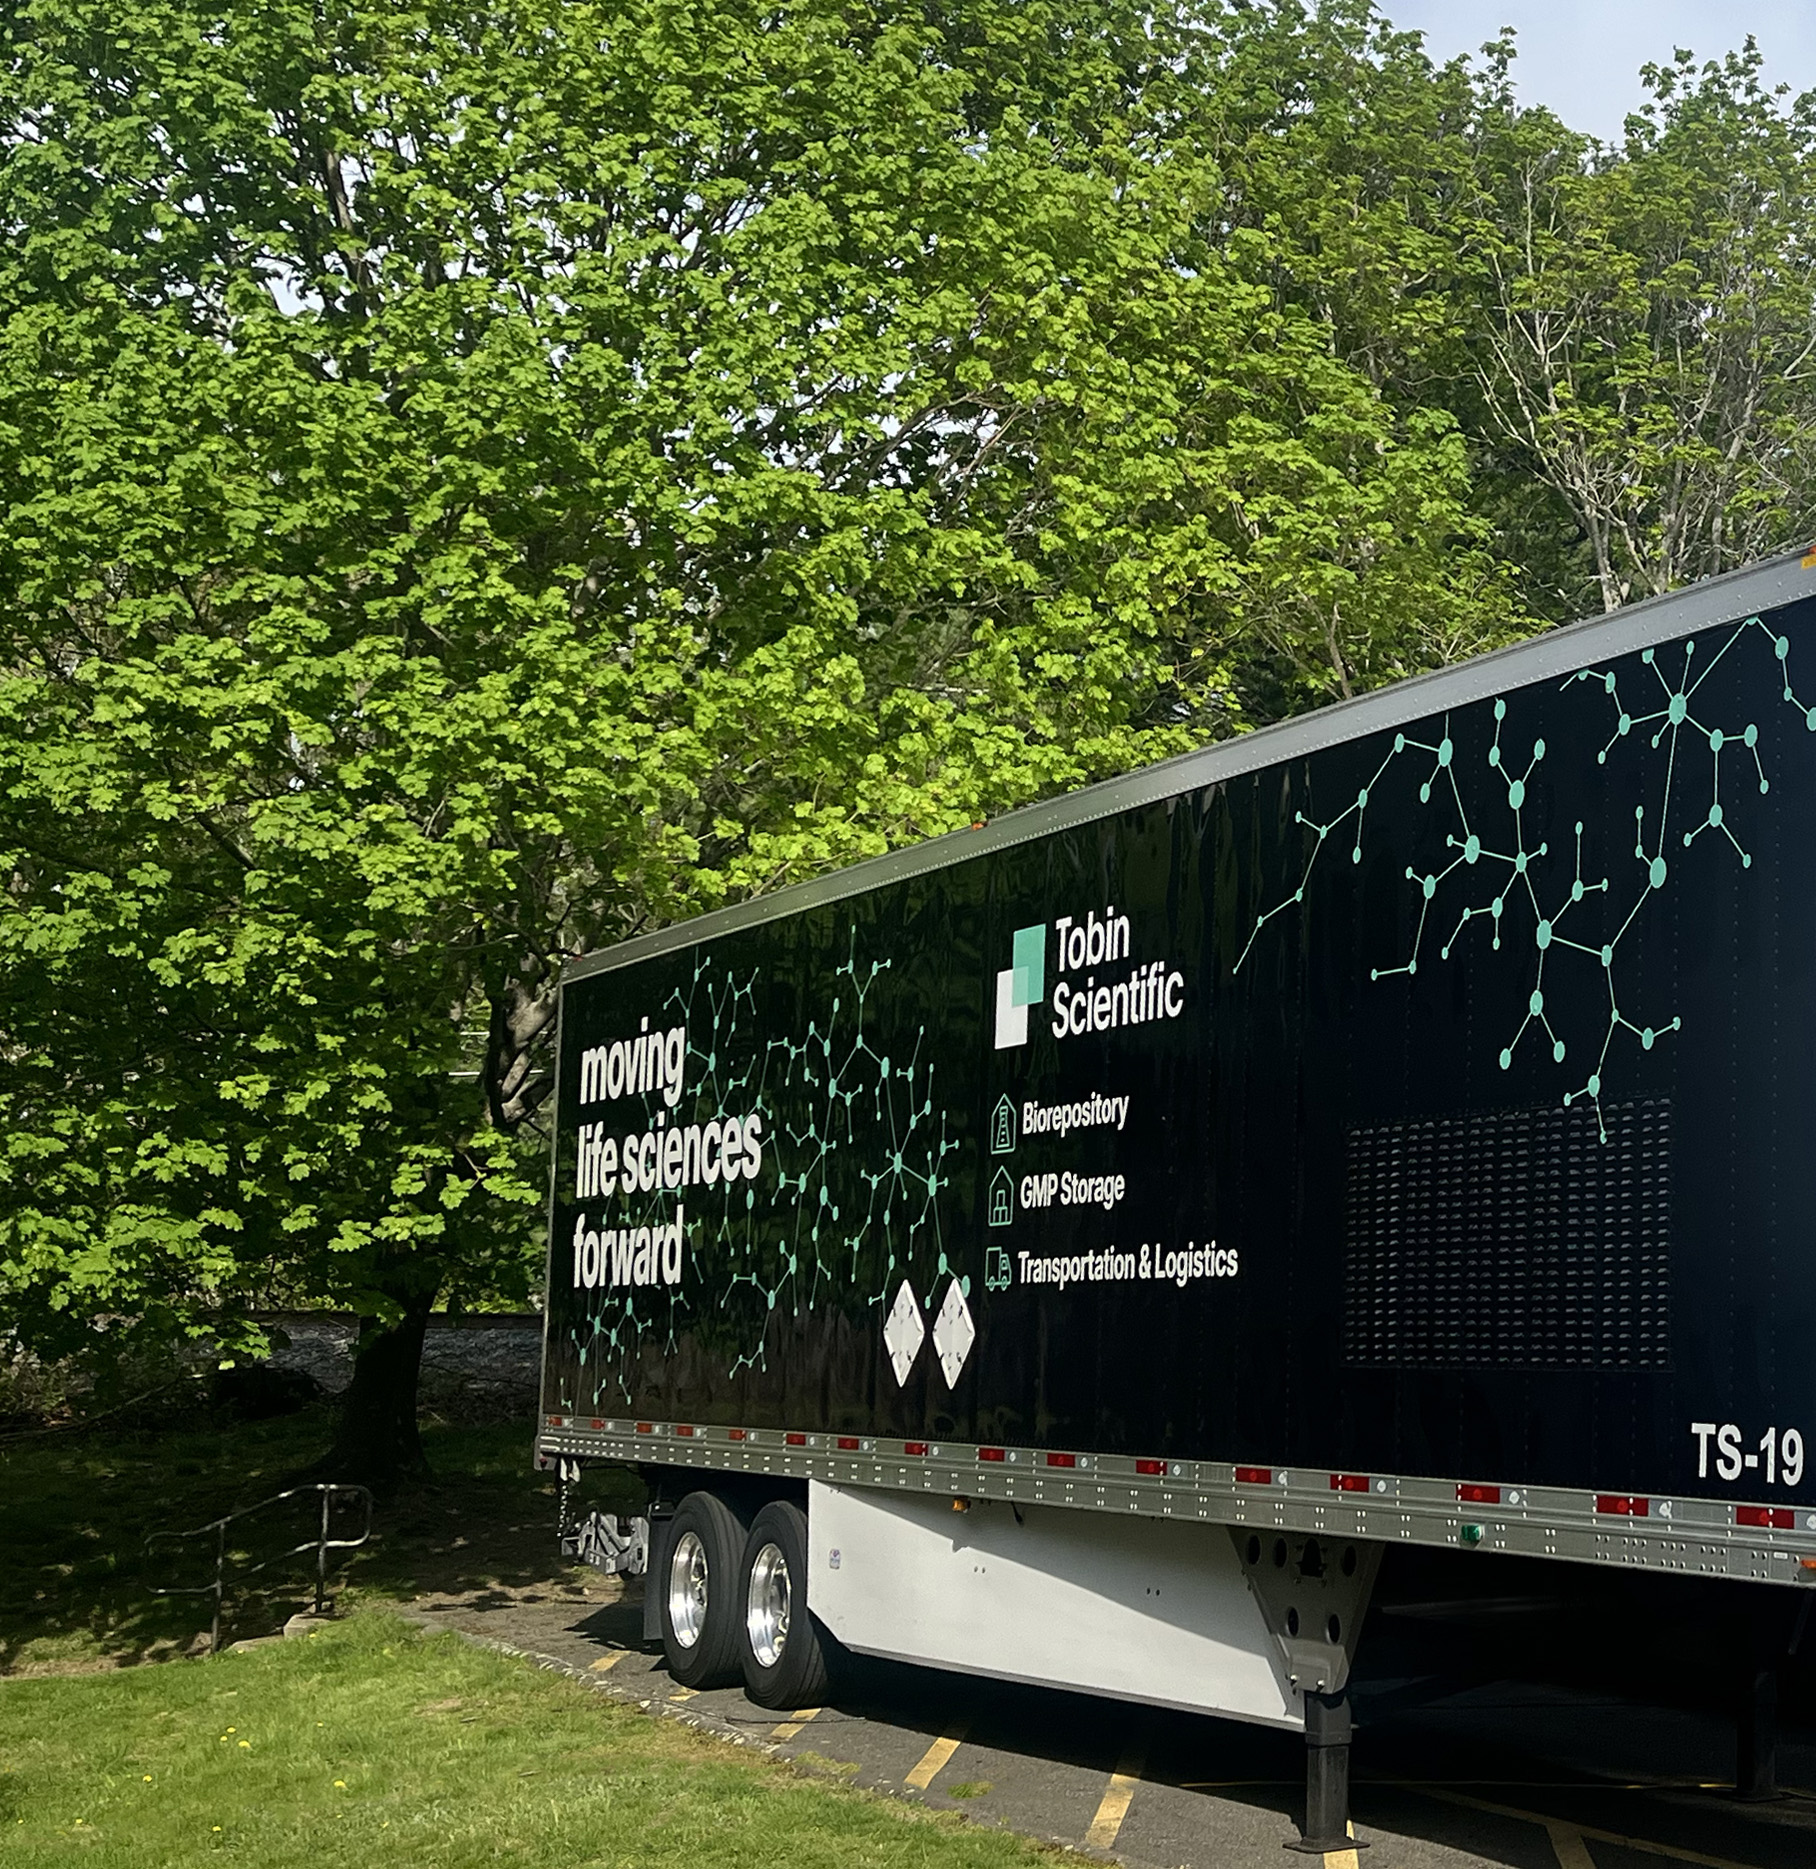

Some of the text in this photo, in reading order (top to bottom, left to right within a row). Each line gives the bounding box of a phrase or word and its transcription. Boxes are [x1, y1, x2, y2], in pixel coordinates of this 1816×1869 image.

[1055, 905, 1130, 972] Tobin
[1052, 961, 1184, 1038] Scientific
[580, 1016, 685, 1107] moving
[1022, 1092, 1129, 1138] Biorepository
[576, 1111, 762, 1198] life sciences
[1020, 1171, 1125, 1210] GMP Storage
[573, 1204, 684, 1288] forward
[1018, 1240, 1239, 1291] Transportation & Logistics
[1691, 1422, 1804, 1486] TS-19
